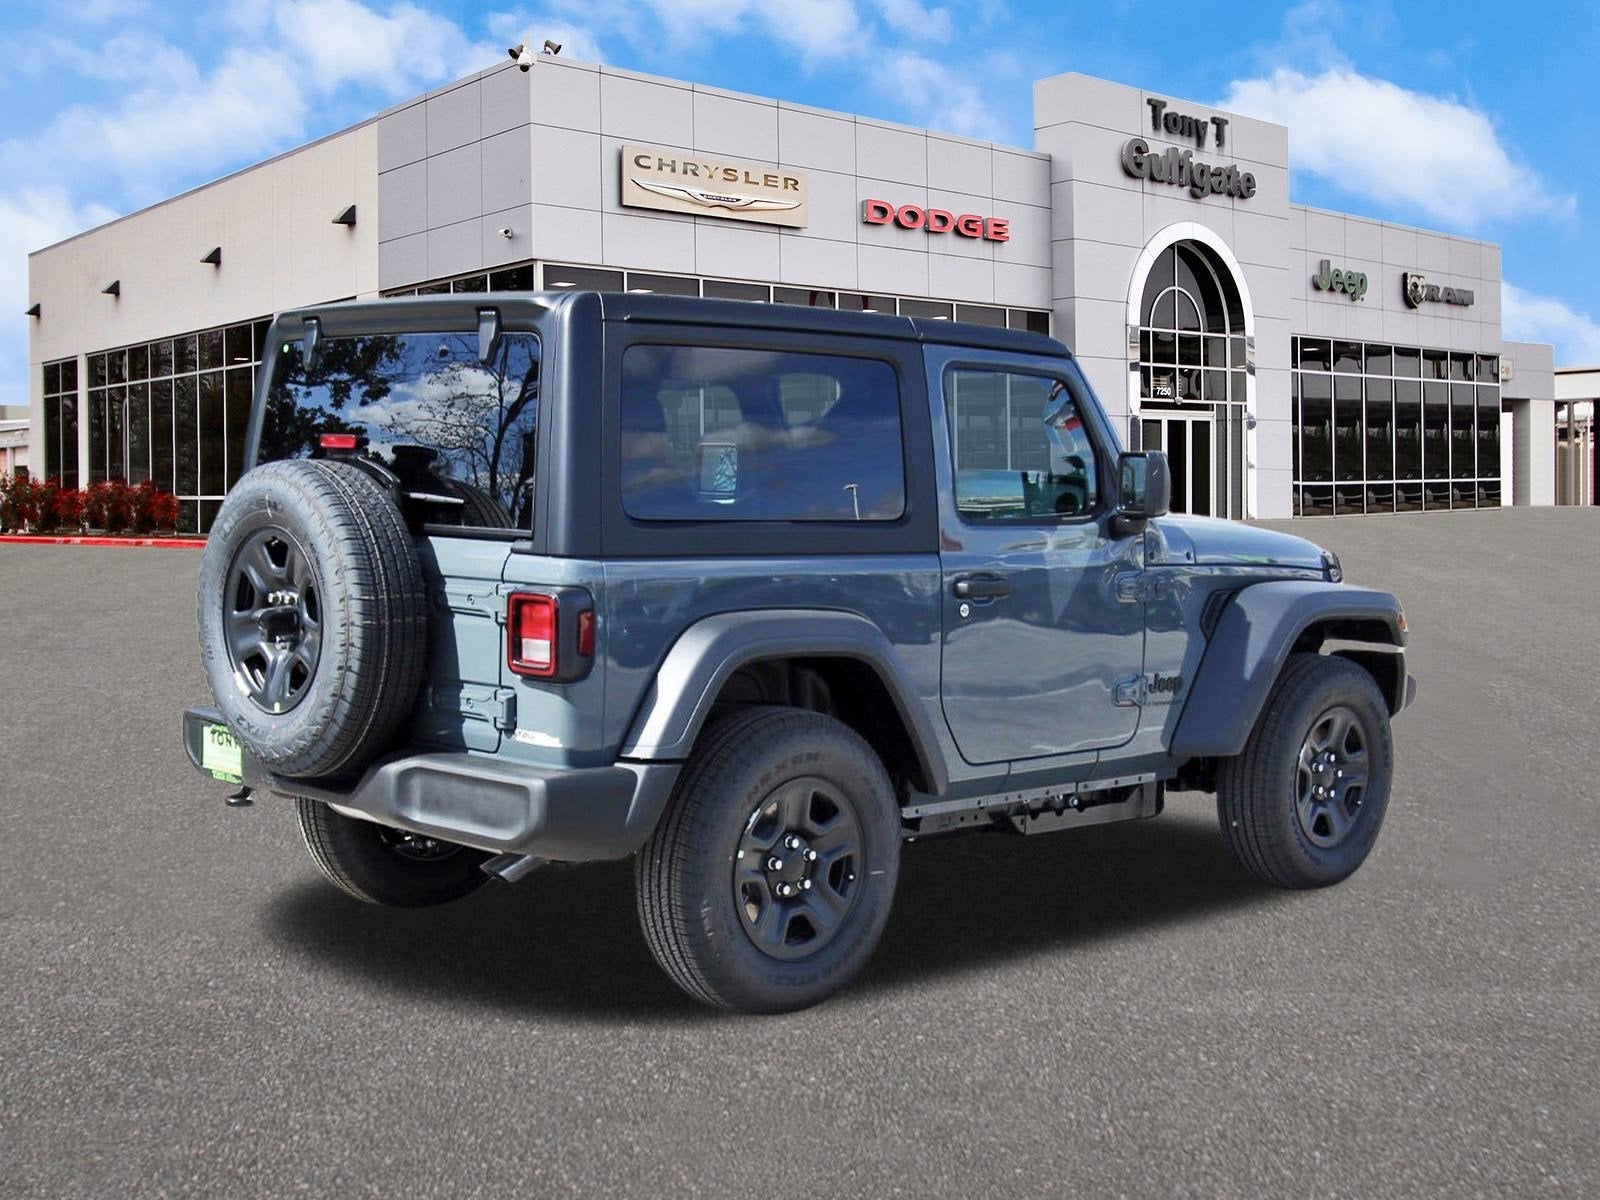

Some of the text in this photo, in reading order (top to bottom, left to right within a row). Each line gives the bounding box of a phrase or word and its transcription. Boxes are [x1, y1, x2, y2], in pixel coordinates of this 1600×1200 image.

[1147, 98, 1229, 148] Tony T
[633, 154, 800, 192] CHRYSLER
[1121, 138, 1257, 199] Gulfgate
[863, 198, 1010, 242] DODGE
[1312, 259, 1368, 302] Jeep
[1424, 284, 1475, 307] RAM
[1156, 386, 1172, 396] 7250
[1148, 672, 1184, 695] Jeep
